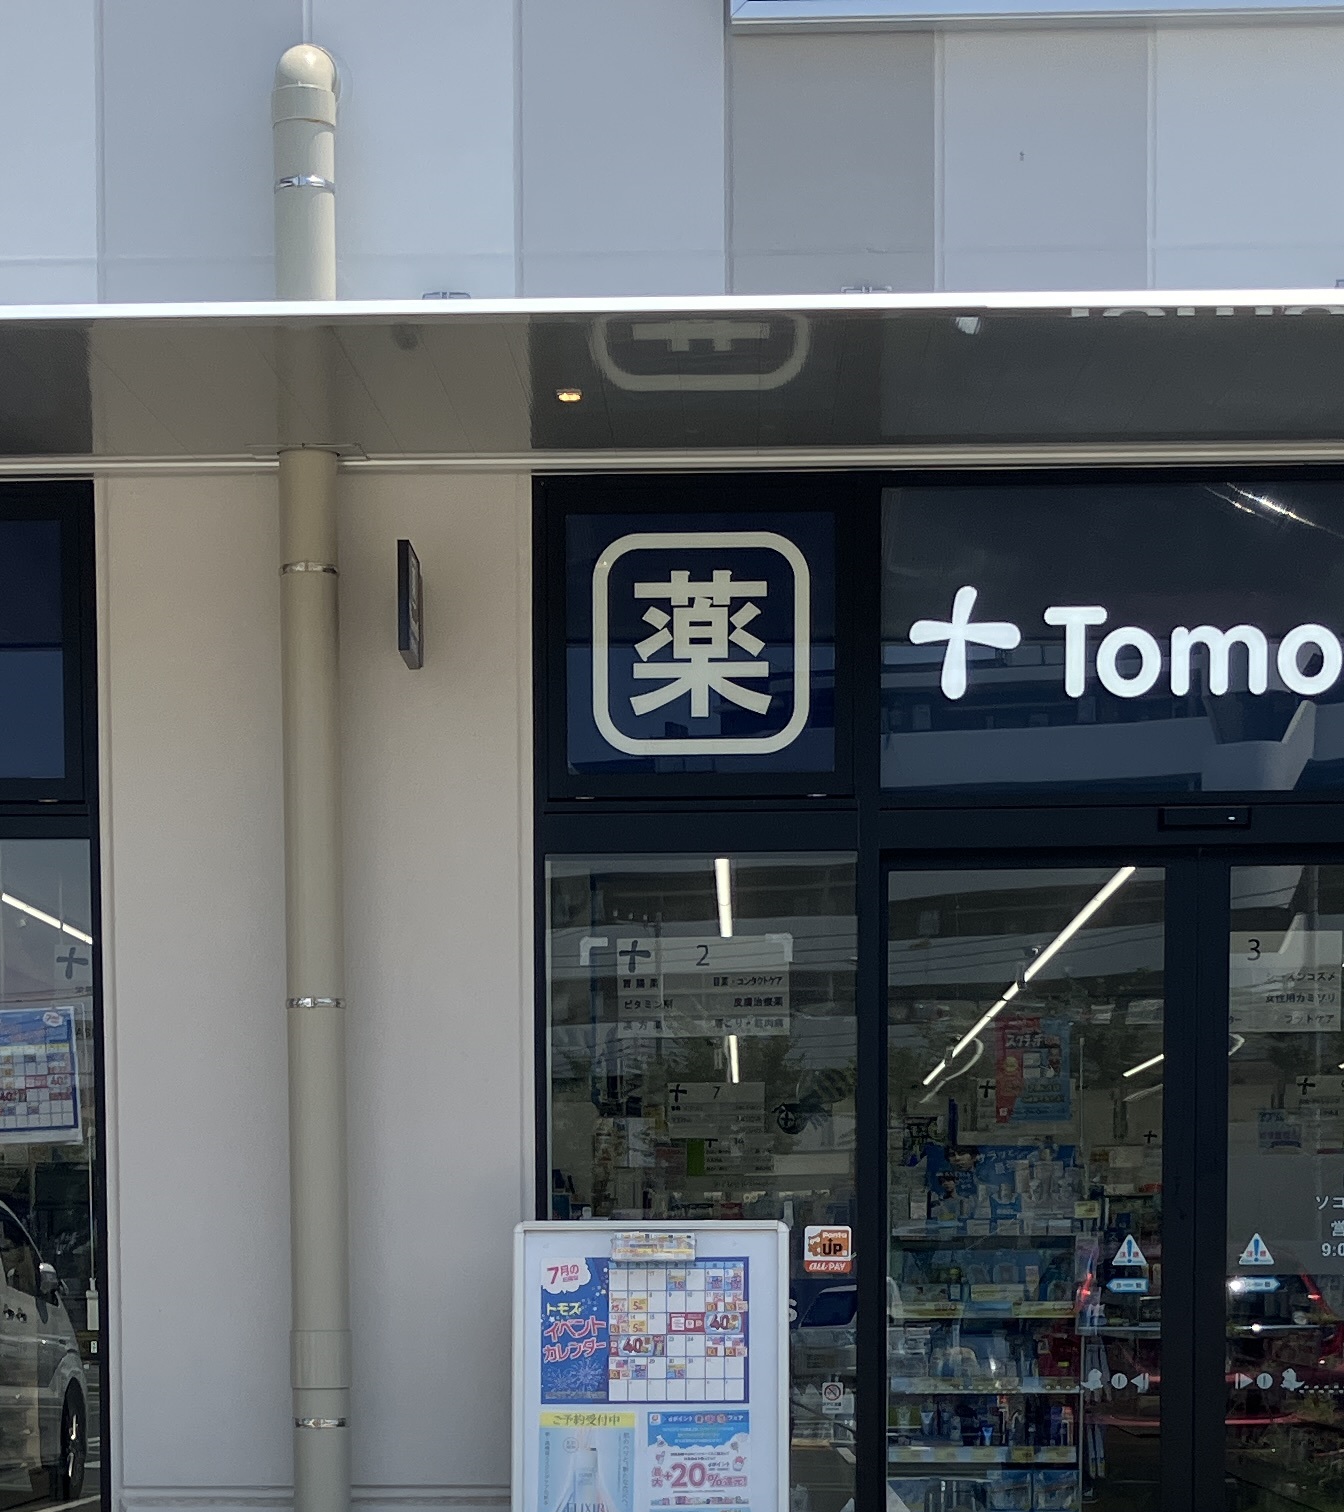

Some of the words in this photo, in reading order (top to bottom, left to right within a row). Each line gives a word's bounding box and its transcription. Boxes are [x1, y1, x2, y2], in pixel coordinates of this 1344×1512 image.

[630, 570, 773, 718] 薬
[695, 944, 710, 966] 2
[1247, 938, 1261, 961] 3
[713, 1086, 721, 1100] 7
[547, 1263, 580, 1285] 7月の
[546, 1302, 581, 1316] トモズ
[544, 1316, 606, 1342] イベント
[543, 1337, 606, 1364] カレンダー
[552, 1413, 621, 1427] ご予約受付中
